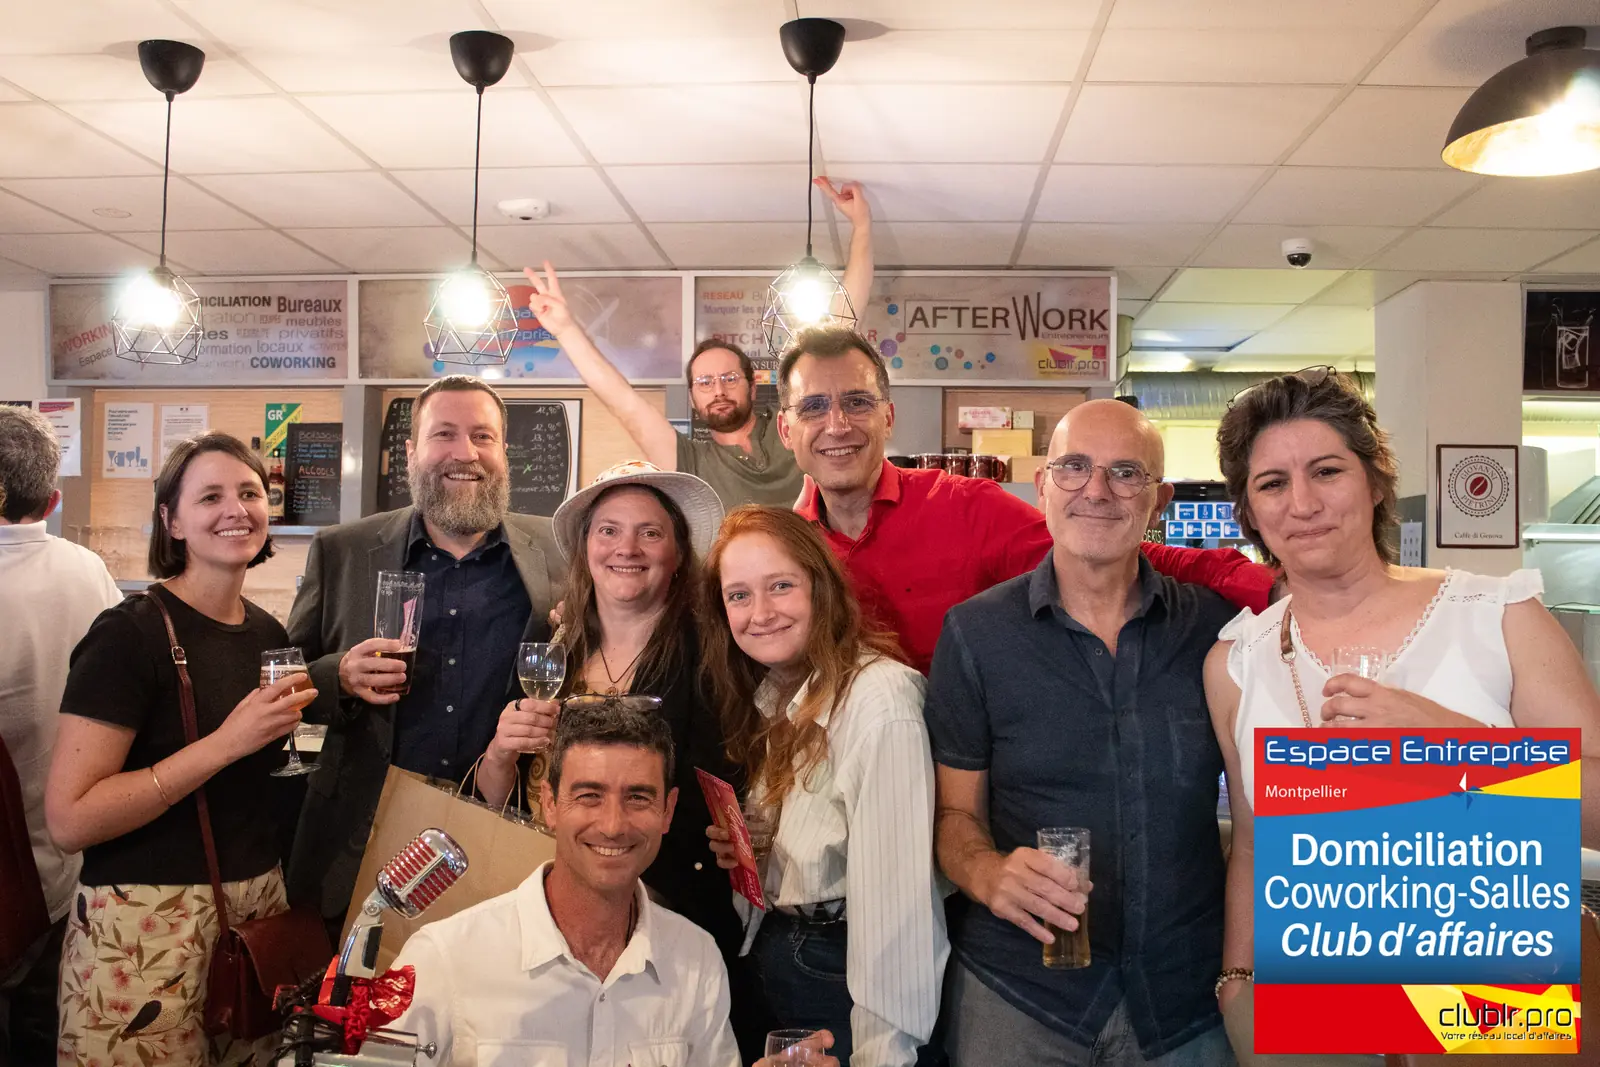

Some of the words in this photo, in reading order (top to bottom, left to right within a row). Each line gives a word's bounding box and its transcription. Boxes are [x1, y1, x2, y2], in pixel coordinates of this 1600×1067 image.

[277, 296, 342, 313] Bureaux
[908, 292, 1109, 341] AFTERWORK
[257, 340, 303, 353] locaux
[79, 346, 113, 367] Espace
[250, 356, 336, 369] COWORKING
[1460, 464, 1499, 481] GIOVANNI
[1460, 494, 1497, 509] PIETRINI
